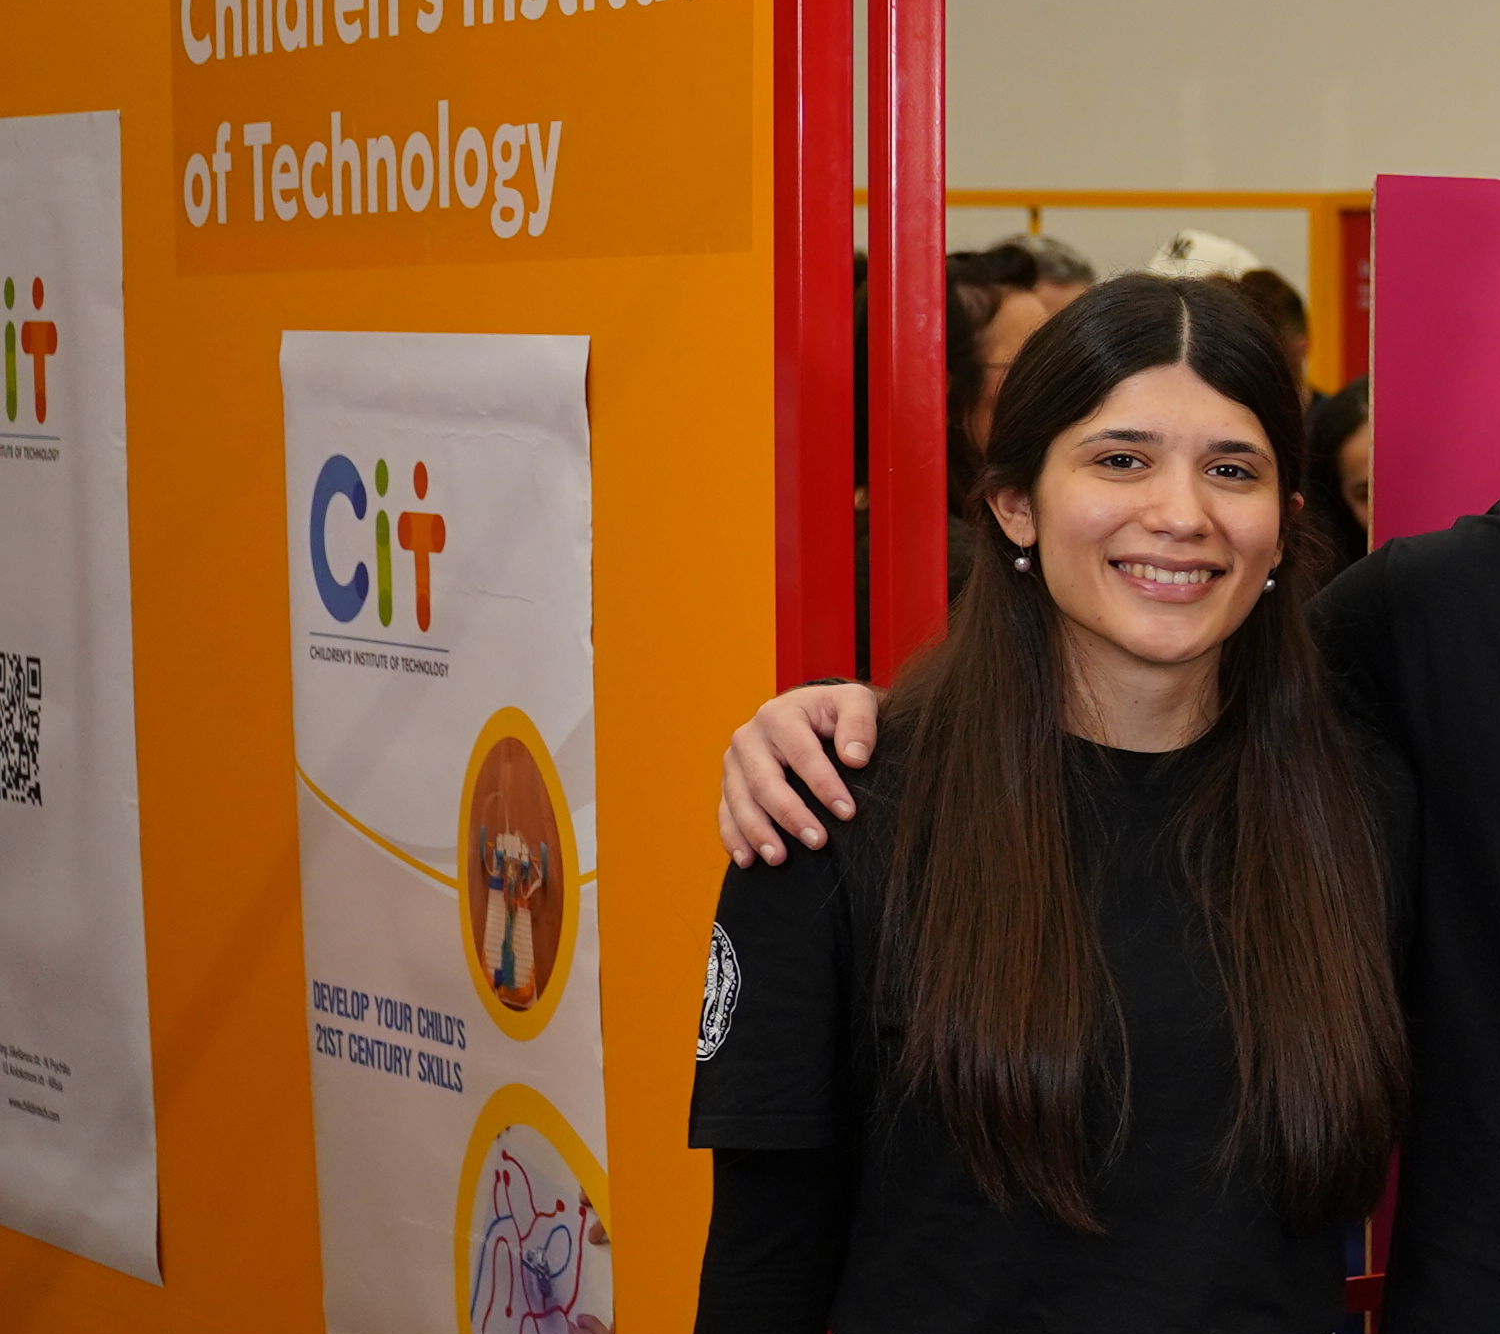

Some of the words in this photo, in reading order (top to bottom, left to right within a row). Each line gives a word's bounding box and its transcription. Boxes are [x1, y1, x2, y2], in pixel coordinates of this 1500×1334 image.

[184, 122, 232, 228] of
[243, 100, 563, 238] Technology
[310, 645, 352, 664] CHILDREN'S
[354, 650, 388, 670] INSTITUTE
[390, 656, 400, 671] OF
[401, 657, 449, 679] TECHNOLOGY
[313, 980, 369, 1022] DEVELOP
[375, 995, 413, 1034] YOUR
[417, 1007, 466, 1051] CHILD'S
[315, 1023, 344, 1058] 21ST
[348, 1033, 412, 1078] CENTURY
[418, 1051, 463, 1093] SKILLS
